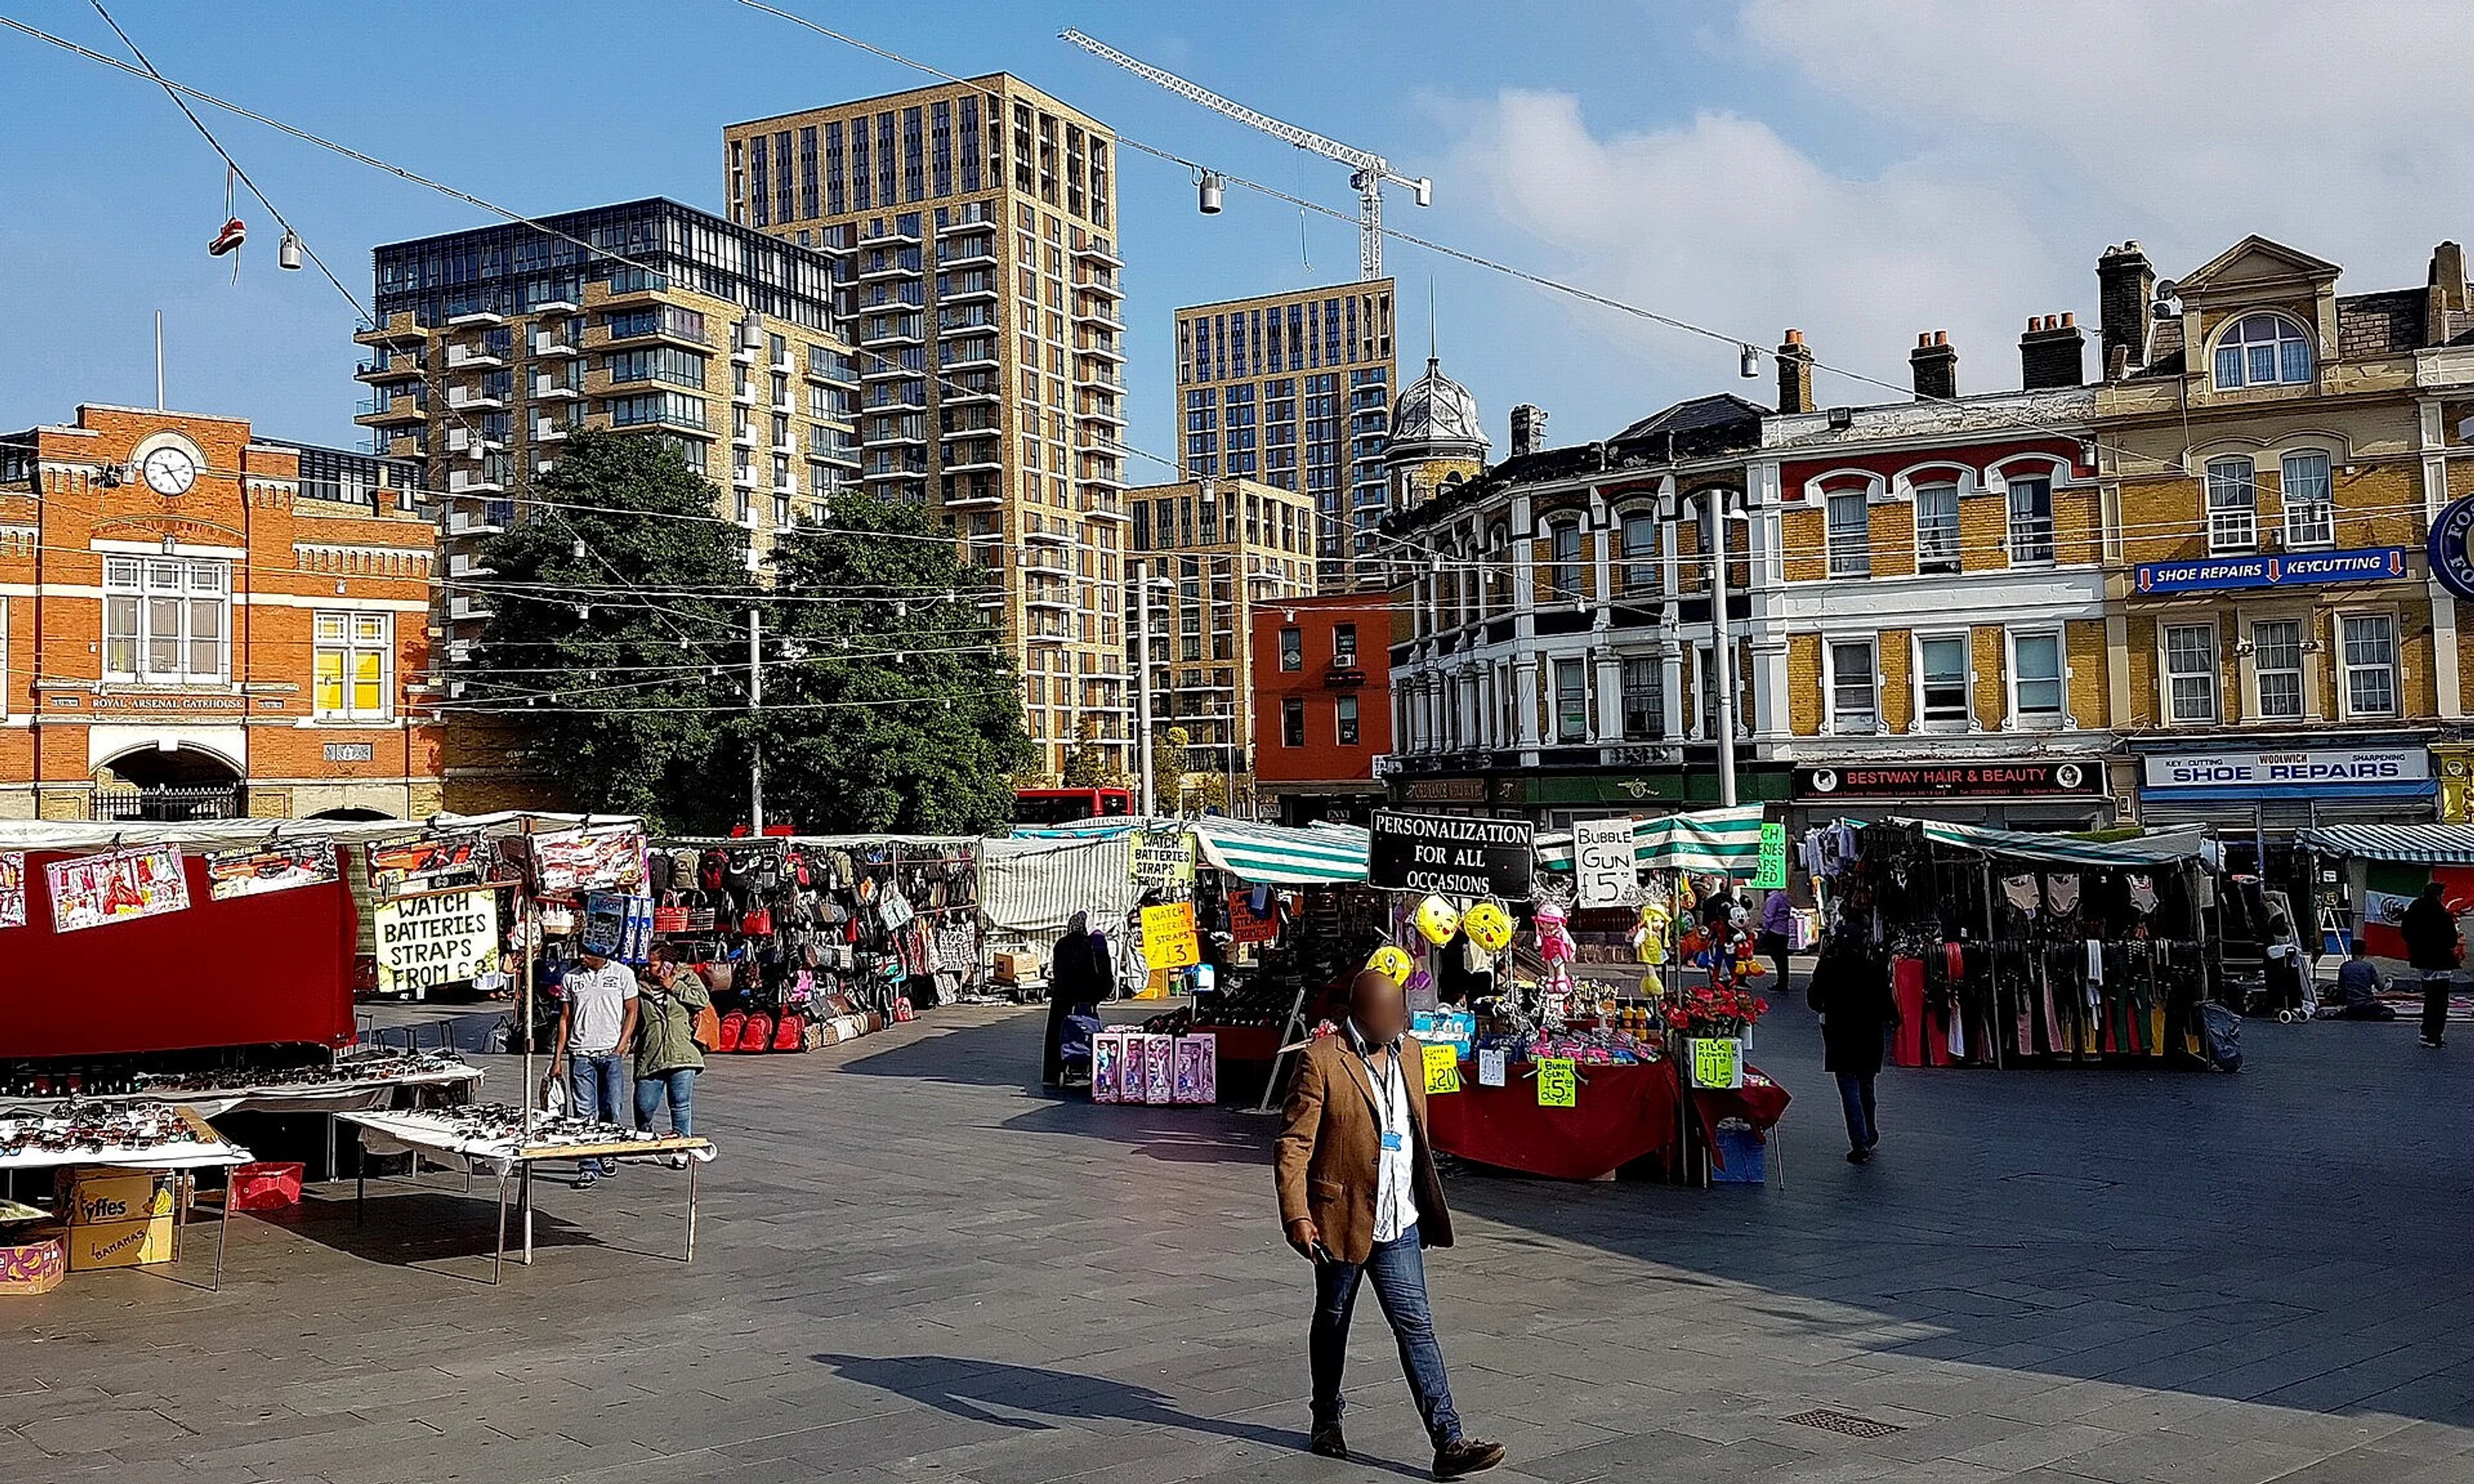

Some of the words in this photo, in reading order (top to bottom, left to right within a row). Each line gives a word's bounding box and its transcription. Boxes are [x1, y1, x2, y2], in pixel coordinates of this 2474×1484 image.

[2156, 569, 2196, 582] SHOE
[2200, 564, 2262, 579] REPAIRS
[2287, 557, 2381, 575] KEYCUTTING
[92, 698, 128, 708] ROYAL
[131, 699, 180, 708] ARSENAL
[183, 699, 244, 709] GATEHOUSE
[2259, 754, 2308, 764] WOOLWICH
[2352, 754, 2406, 763] SHARPENING
[1847, 771, 1919, 785] BESTWAY
[1924, 770, 1962, 783] HAIR
[1967, 770, 1979, 783] &
[1982, 768, 2047, 783] BEAUTY
[2173, 766, 2252, 782] SHOE
[2270, 763, 2399, 779] REPAIRS
[1375, 815, 1529, 844] PERSONALIZATION
[1578, 828, 1632, 845] BUBBLE
[1142, 836, 1179, 849] WATCH
[1135, 849, 1191, 863] BATTERIES
[1414, 844, 1447, 864] FOR
[1454, 848, 1486, 867] ALL
[1582, 847, 1630, 868] GUN
[1136, 862, 1175, 875] STRAPS
[1406, 870, 1490, 894] OCCASIONS
[397, 891, 470, 918] WATCH
[1149, 906, 1185, 921] WATCH
[384, 913, 486, 943] BATTERIES
[1146, 918, 1193, 935] BATTERIES
[1155, 931, 1189, 945] STRAPS
[390, 938, 472, 966] STRAPS
[392, 963, 448, 993] FROM
[1698, 1042, 1725, 1051] SILK
